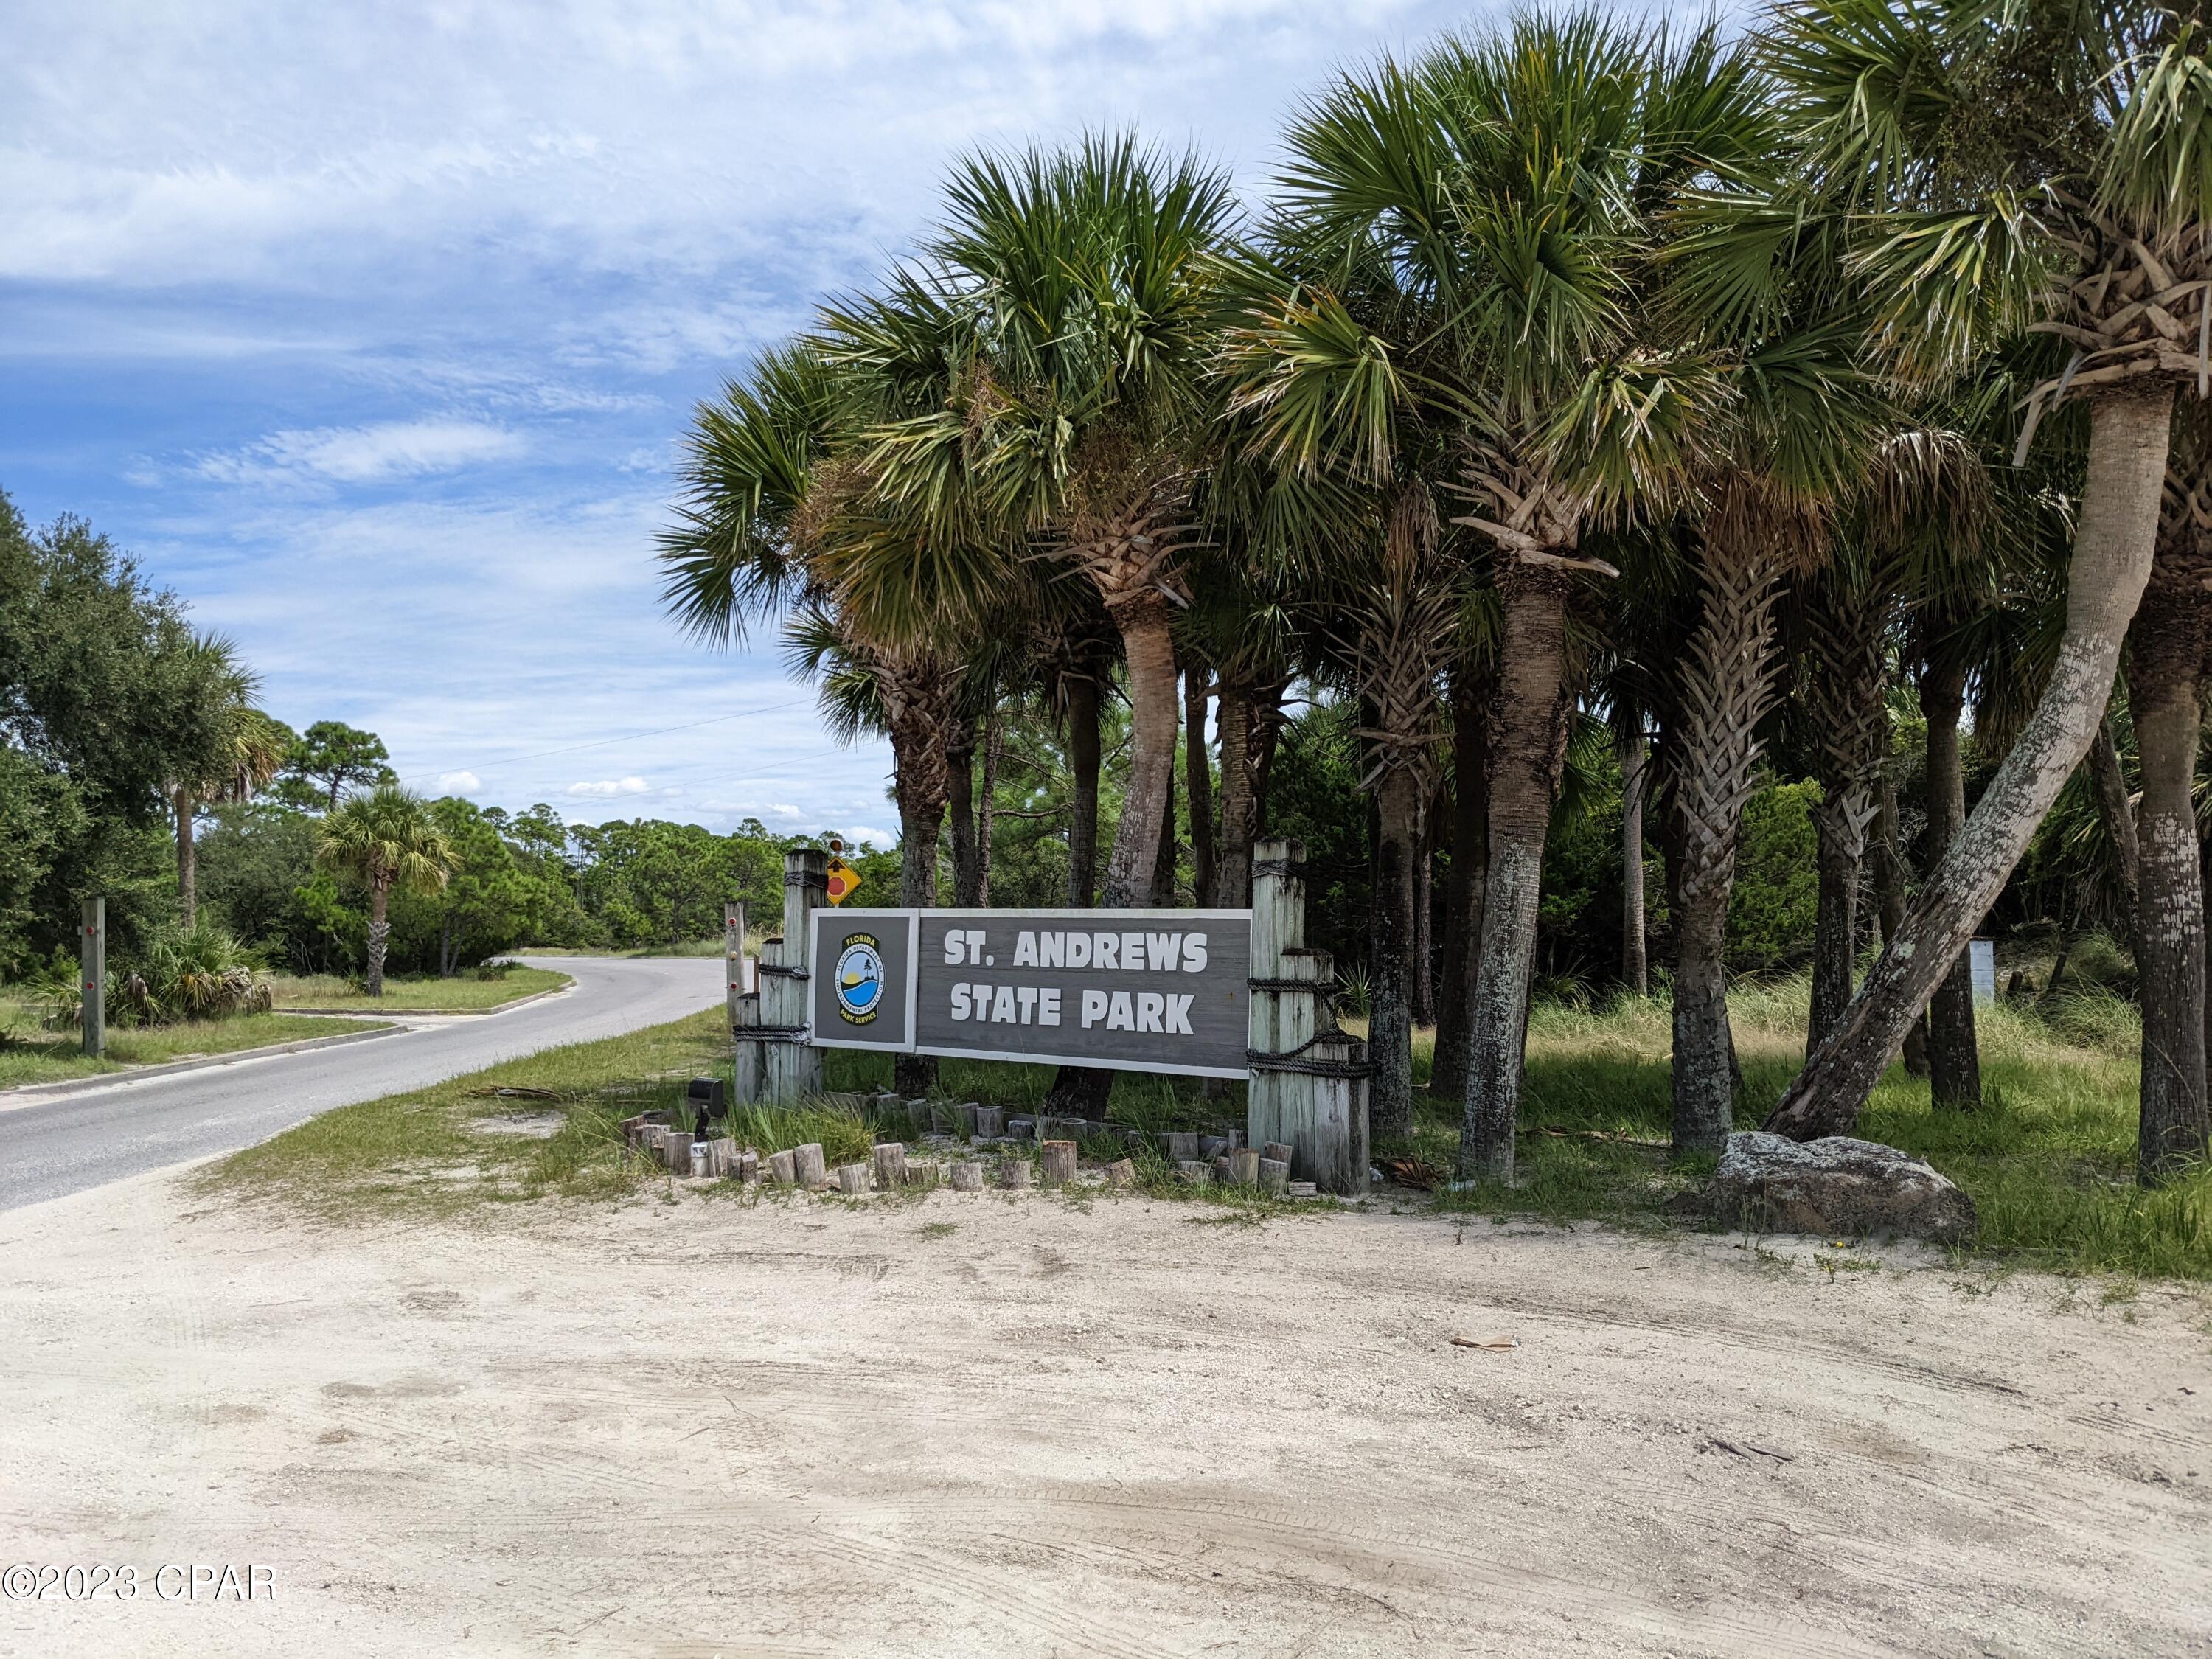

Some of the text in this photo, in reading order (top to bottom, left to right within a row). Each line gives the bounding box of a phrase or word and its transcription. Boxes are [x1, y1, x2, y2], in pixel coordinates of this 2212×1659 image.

[846, 935, 875, 947] FLORIDA
[945, 929, 1208, 973] ST. ANDREWS
[838, 945, 883, 973] FLORIDA DEPARTMENT OF
[835, 978, 883, 1013] ENVIRONMENTAL PROTECTION
[950, 982, 1195, 1034] STATE PARK
[840, 1009, 877, 1023] PARK SERVICE
